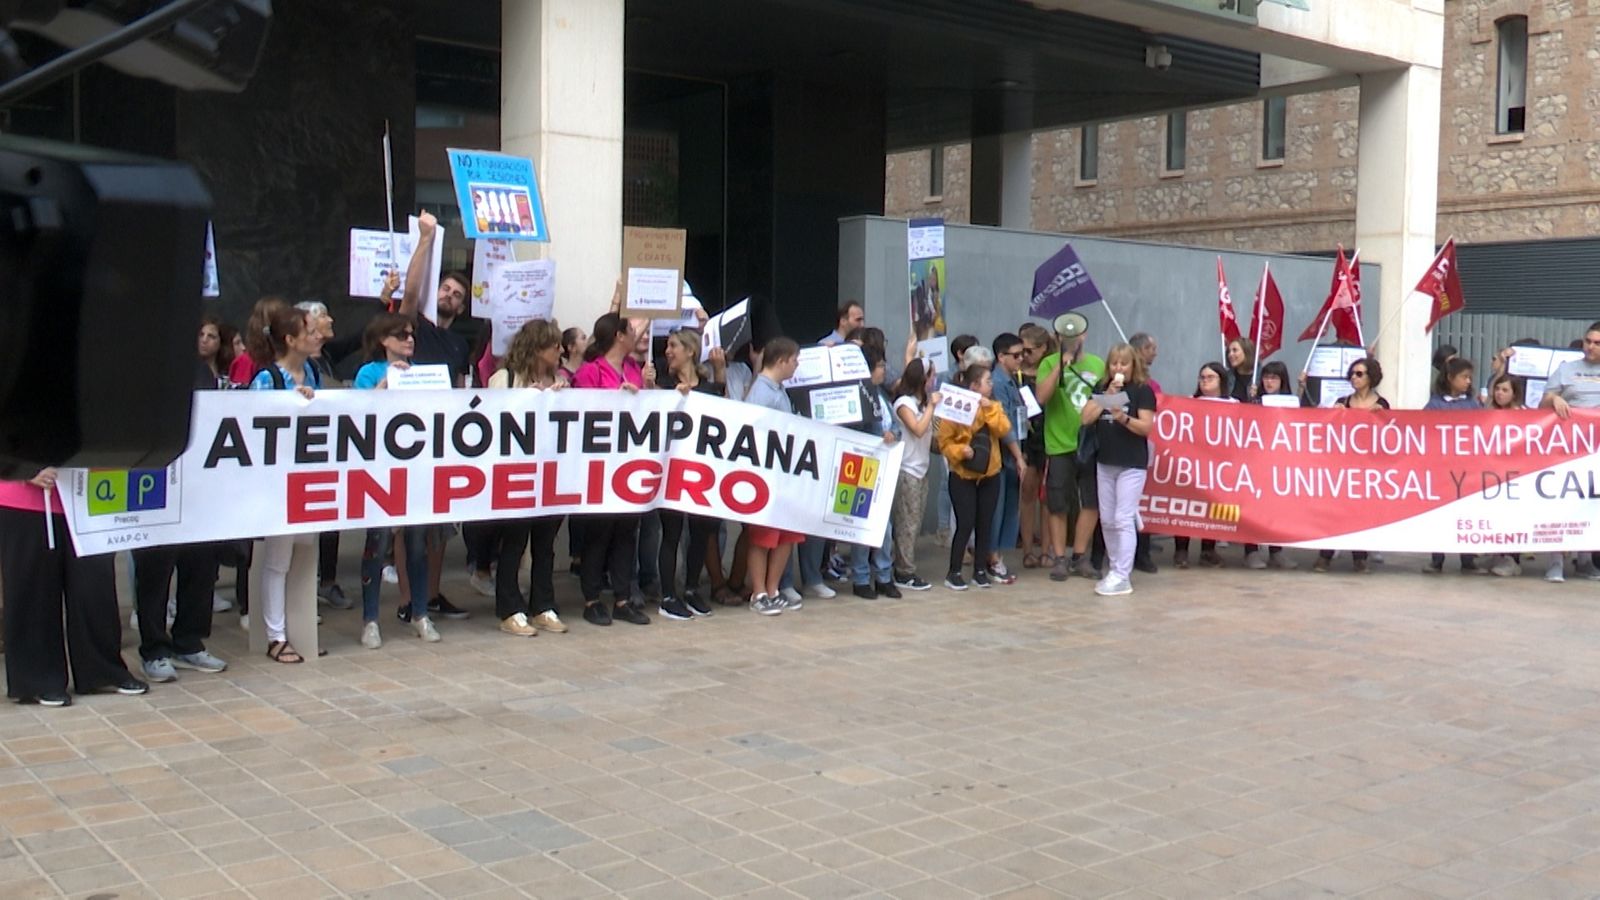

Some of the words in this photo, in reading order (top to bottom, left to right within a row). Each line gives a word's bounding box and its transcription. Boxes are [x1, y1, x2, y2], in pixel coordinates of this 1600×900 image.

[457, 154, 473, 169] NO
[203, 395, 536, 468] ATENCIÓN
[549, 410, 820, 481] TEMPRANA
[1153, 409, 1195, 444] OR
[1205, 414, 1265, 450] UNA
[1271, 418, 1426, 456] ATENCIÓN
[1435, 423, 1600, 456] TEMPRAN
[287, 467, 408, 525] EN
[432, 458, 770, 515] PELIGRO
[1153, 448, 1262, 499] ÚBLICA,
[1272, 465, 1441, 501] UNIVERSAL
[1450, 471, 1466, 500] Y
[1482, 470, 1521, 500] DE
[1535, 470, 1600, 499] CAL
[1456, 519, 1473, 530] ES
[1479, 519, 1493, 530] EL
[1456, 532, 1528, 545] MOMENT!
